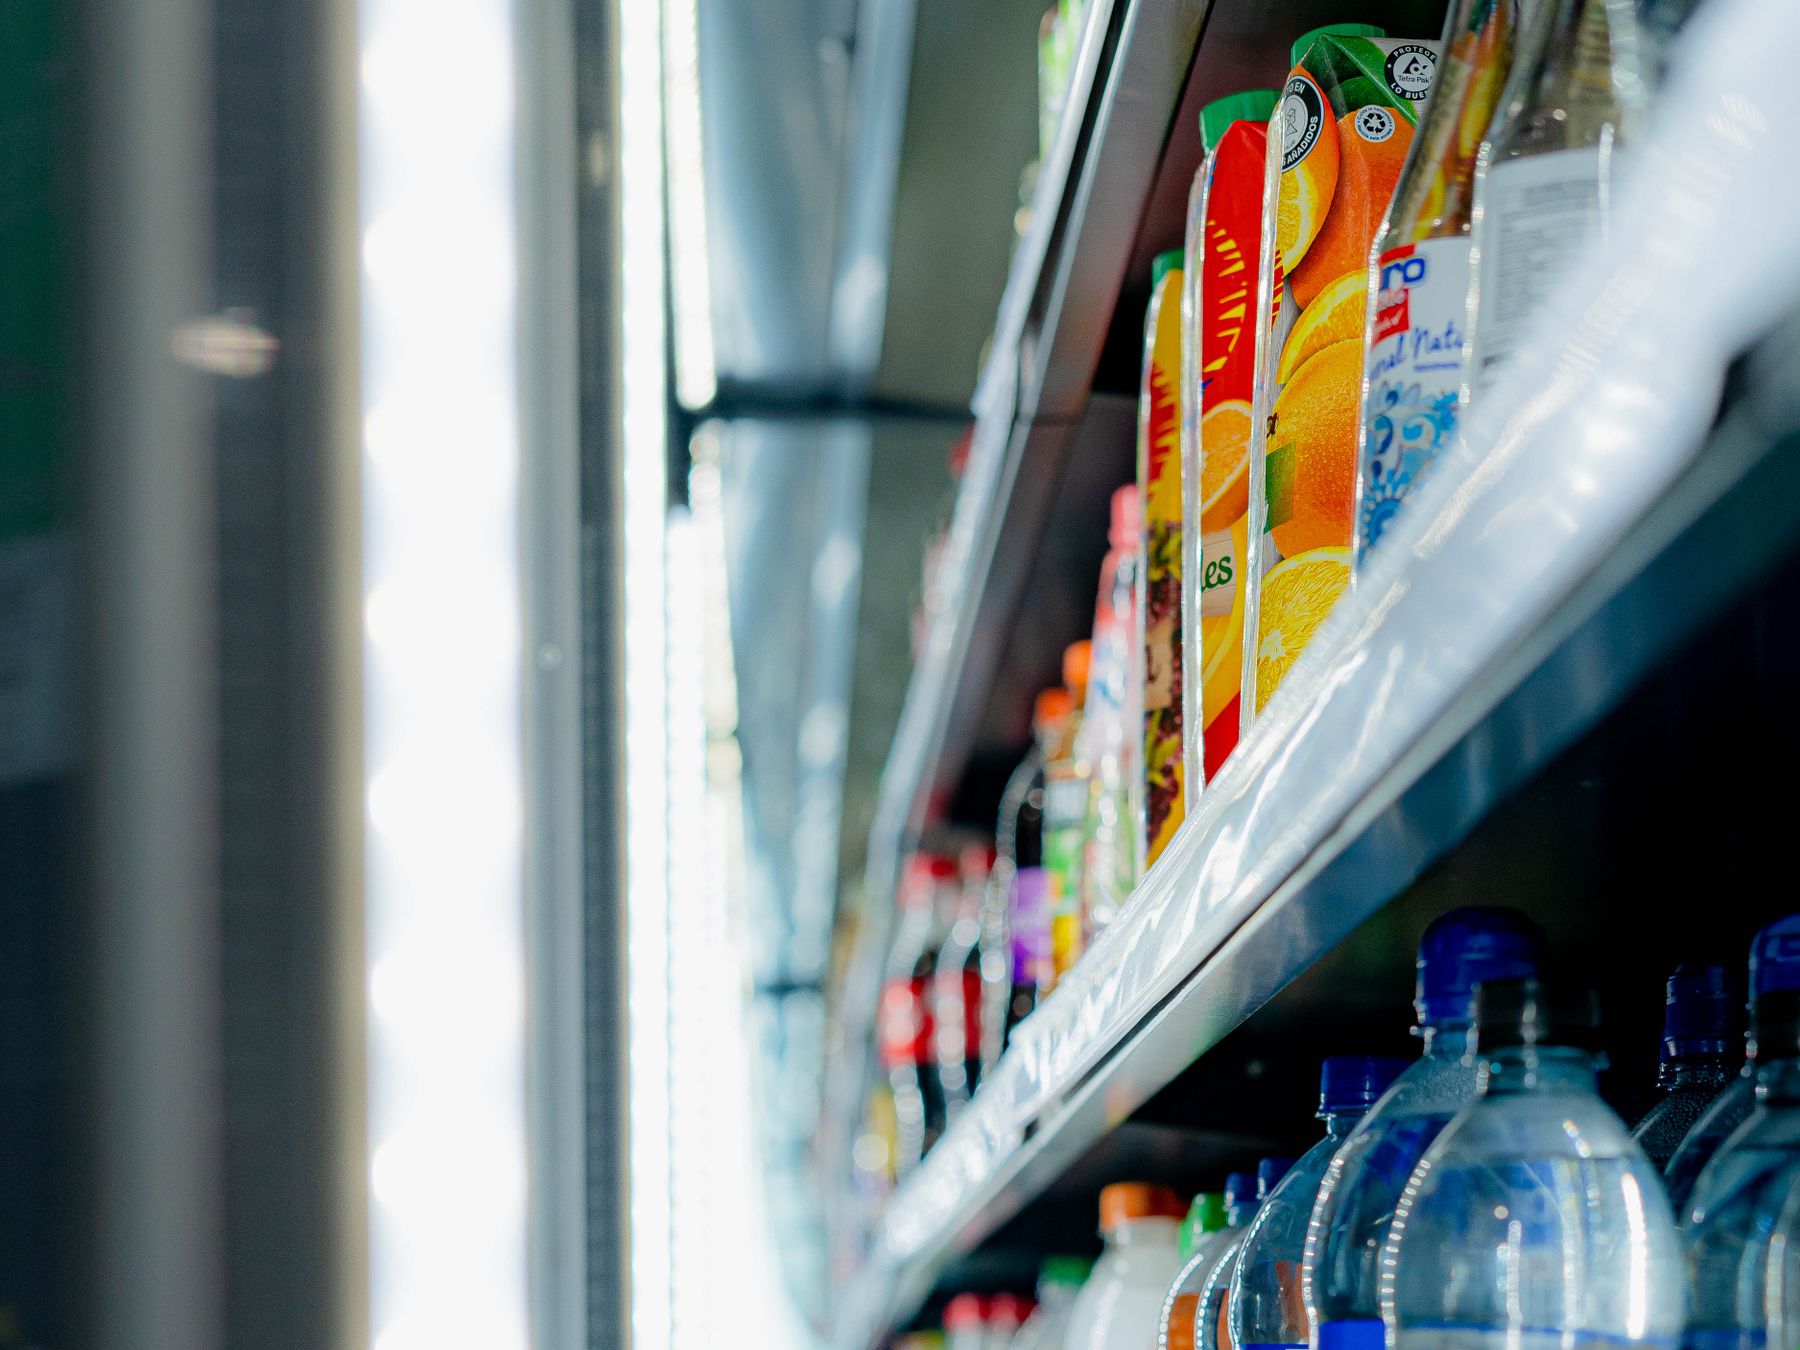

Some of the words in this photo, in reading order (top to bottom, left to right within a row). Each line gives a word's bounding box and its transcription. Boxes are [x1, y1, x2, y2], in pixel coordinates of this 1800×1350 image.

[1393, 46, 1437, 61] PROTEGE
[1294, 81, 1306, 95] EN
[1390, 82, 1402, 94] LO
[1287, 115, 1318, 164] AÑADIDOS
